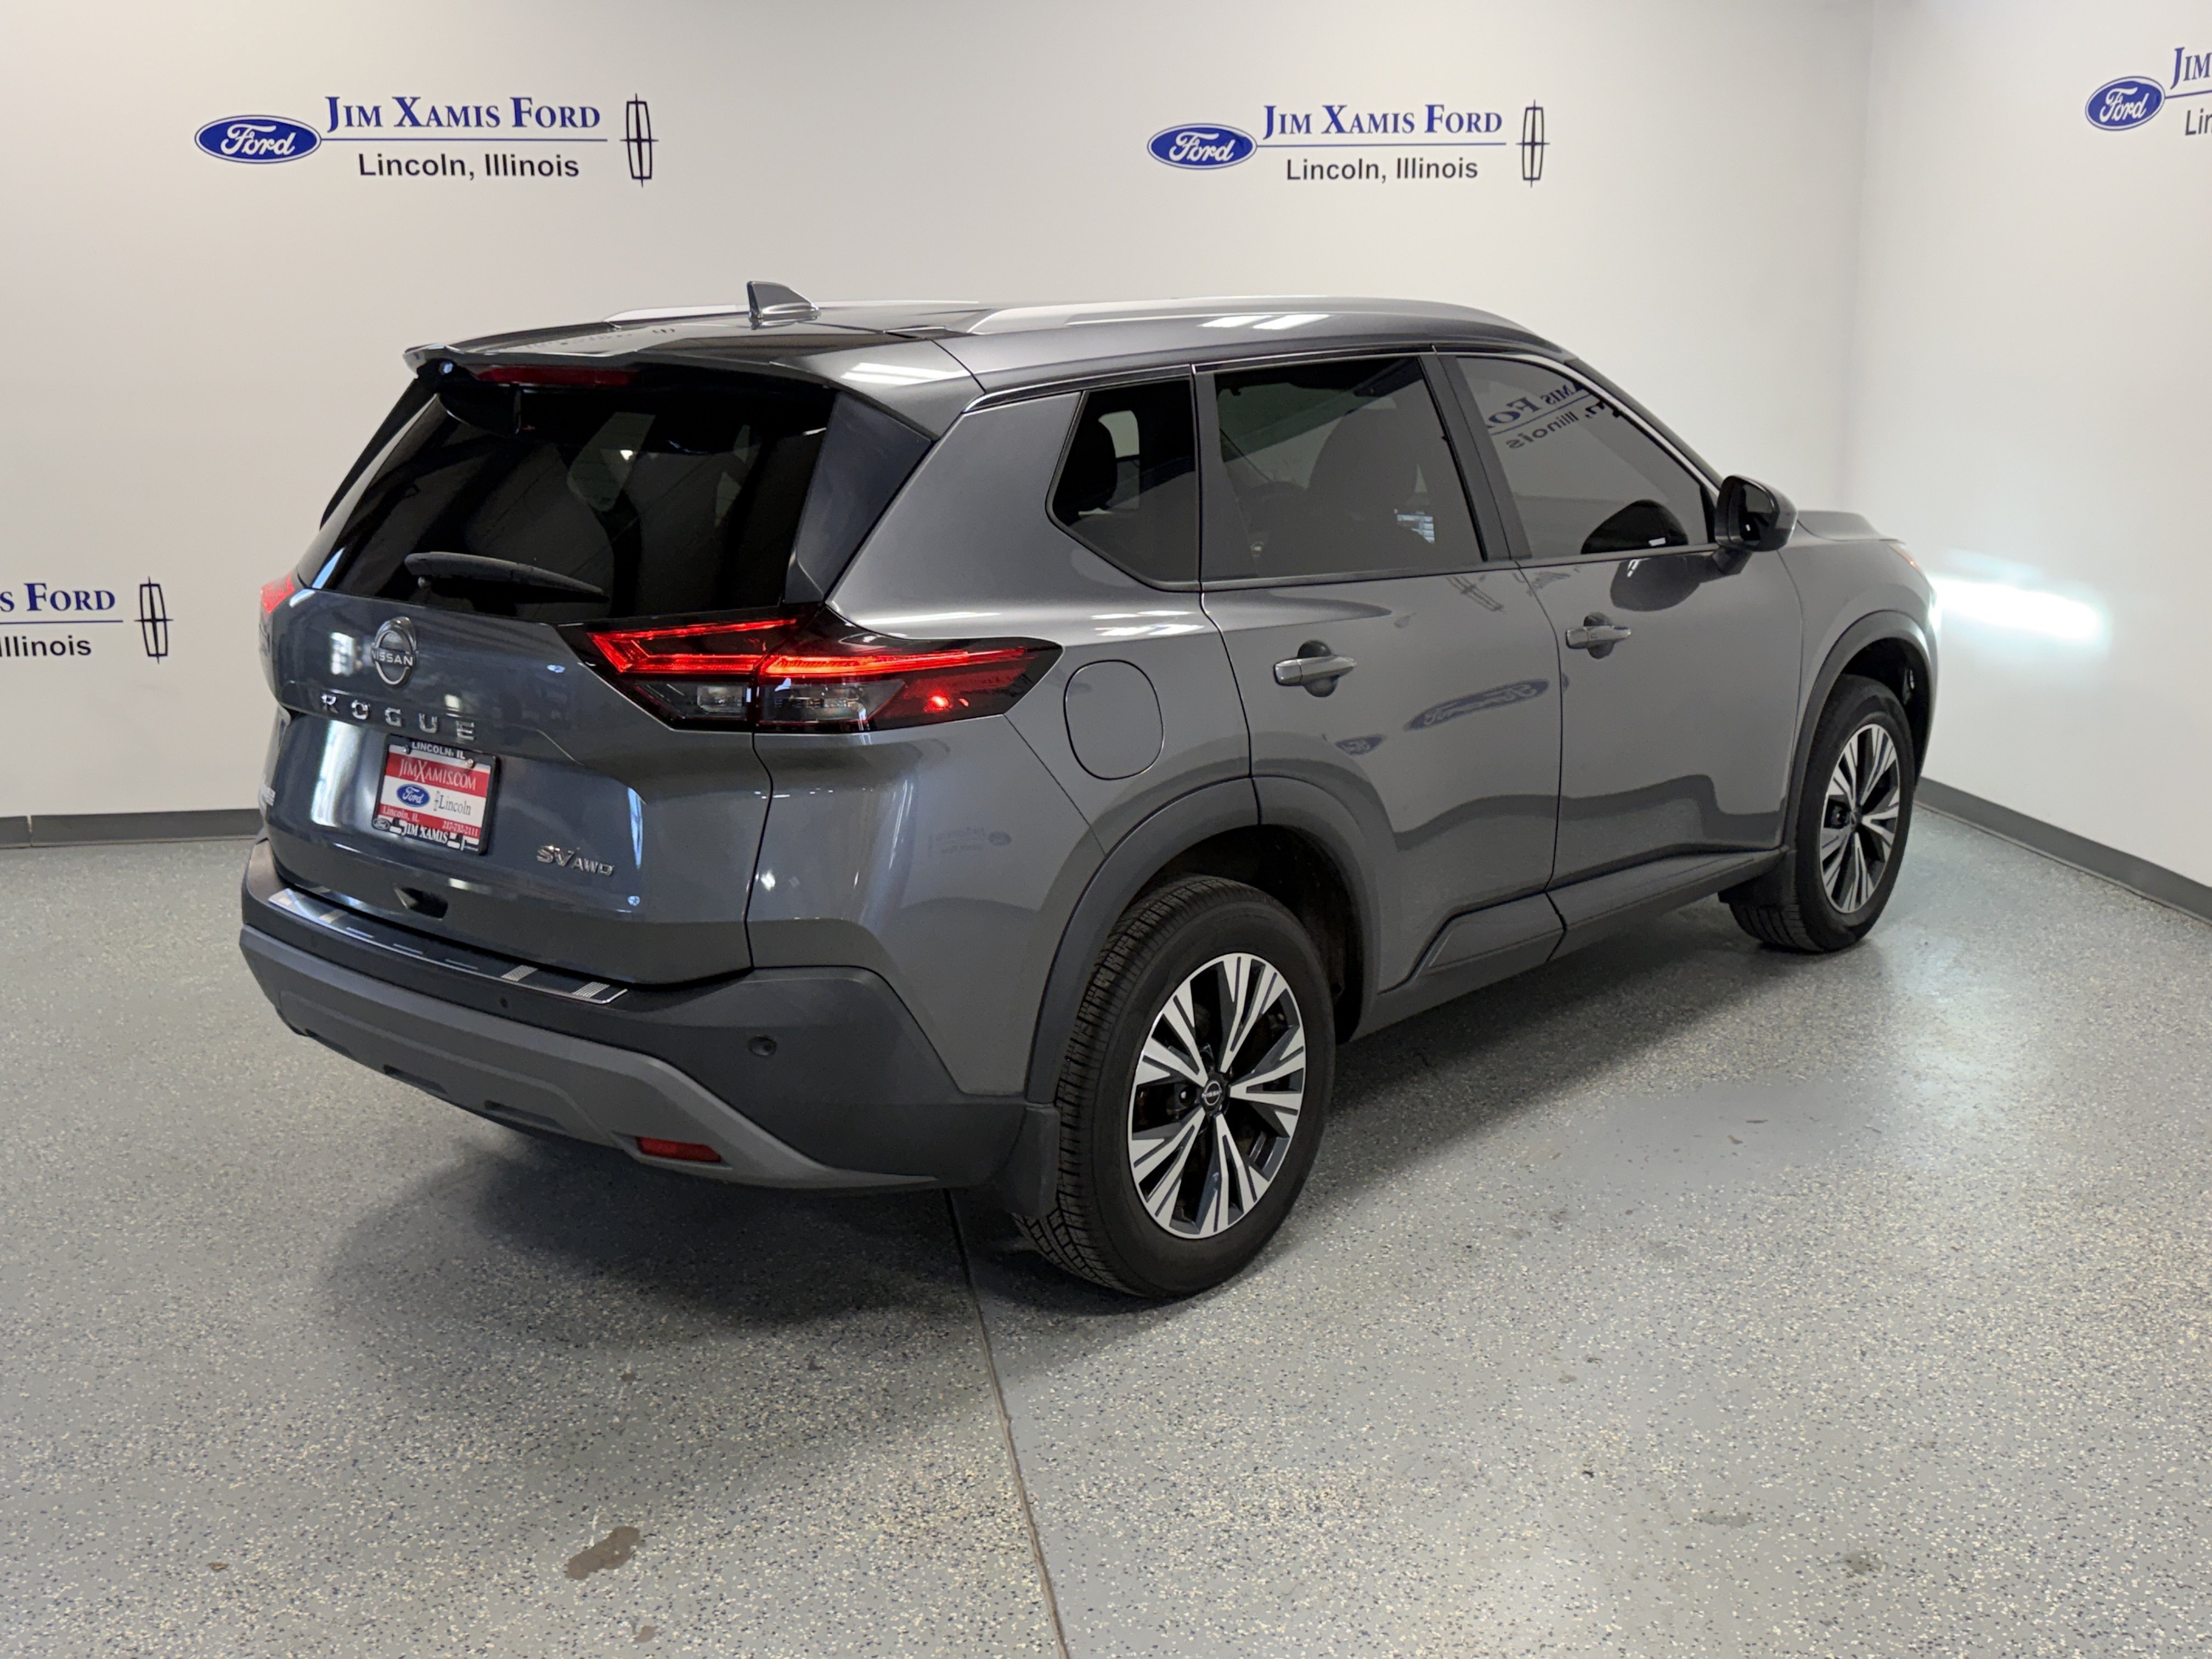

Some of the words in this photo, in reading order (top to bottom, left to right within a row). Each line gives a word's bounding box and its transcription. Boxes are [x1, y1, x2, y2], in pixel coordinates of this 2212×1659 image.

[2170, 47, 2212, 90] JIM
[325, 96, 383, 133] JIM
[392, 96, 501, 128] XAMIS
[510, 97, 601, 128] FORD
[2099, 87, 2149, 123] Ford
[1262, 105, 1312, 140] JIM
[1321, 104, 1415, 134] XAMIS
[1425, 104, 1503, 134] FORD
[220, 123, 297, 155] Ford
[1169, 131, 1236, 162] Ford
[358, 153, 475, 181] Lincoln,
[484, 153, 580, 178] Illinois
[1286, 158, 1387, 183] Lincoln,
[1396, 157, 1479, 179] Illinois
[23, 582, 116, 612] FORD
[371, 649, 413, 666] NISSAN
[320, 693, 475, 741] ROGUE
[411, 741, 454, 757] LINCOLN,
[456, 749, 466, 760] IL
[402, 786, 424, 804] Ford
[438, 794, 472, 815] Lincoln
[402, 823, 420, 836] JIM
[419, 825, 449, 844] XAMIS
[537, 845, 575, 867] SV
[571, 856, 615, 877] AWD
